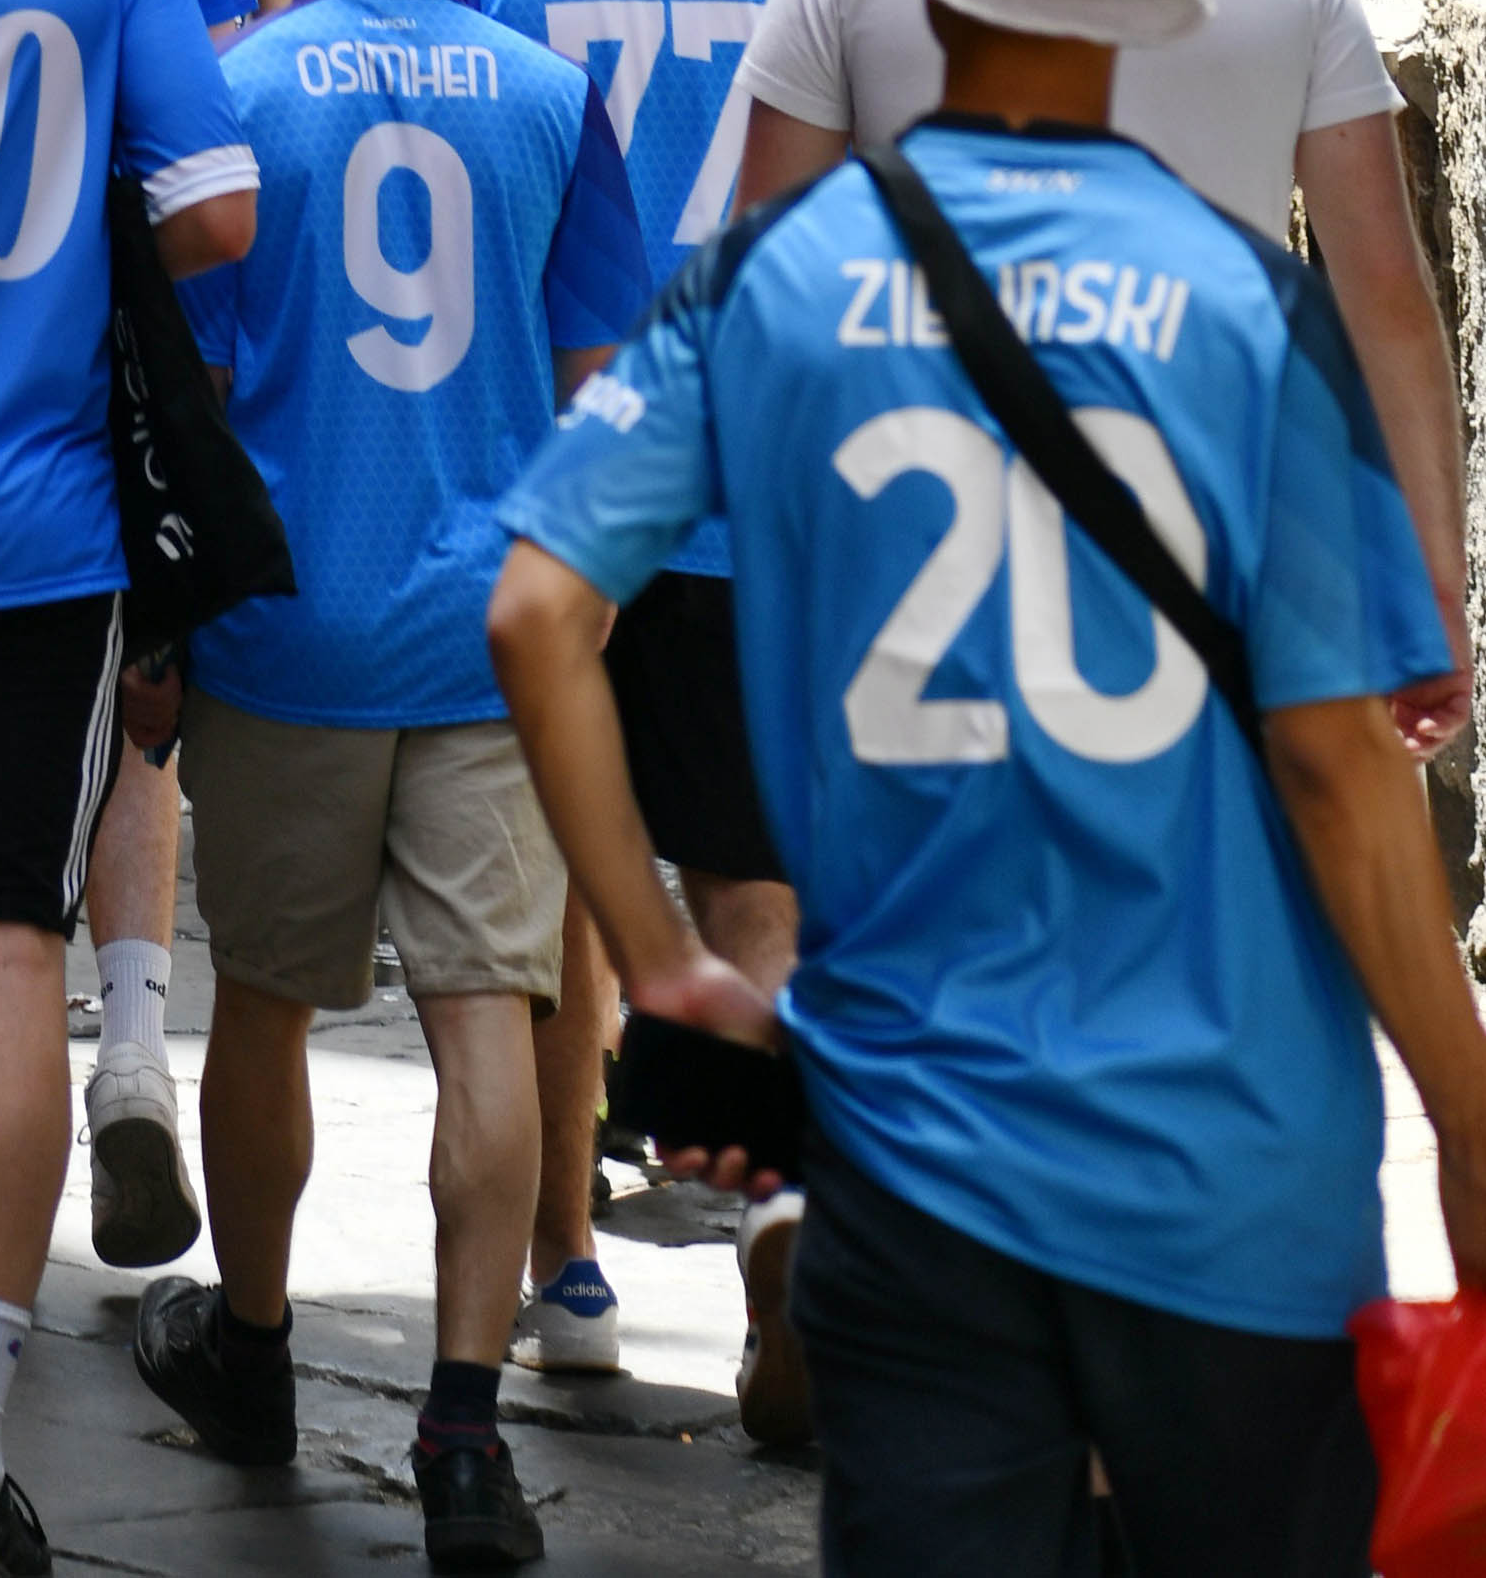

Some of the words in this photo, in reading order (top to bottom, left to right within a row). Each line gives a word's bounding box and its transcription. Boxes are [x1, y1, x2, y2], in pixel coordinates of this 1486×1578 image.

[296, 40, 499, 100] OSIMHEN
[362, 18, 418, 30] NAPOLI
[546, 0, 768, 246] 77
[343, 122, 474, 393] 9
[837, 257, 1191, 364] ZIEINSKI
[833, 406, 1209, 766] 20
